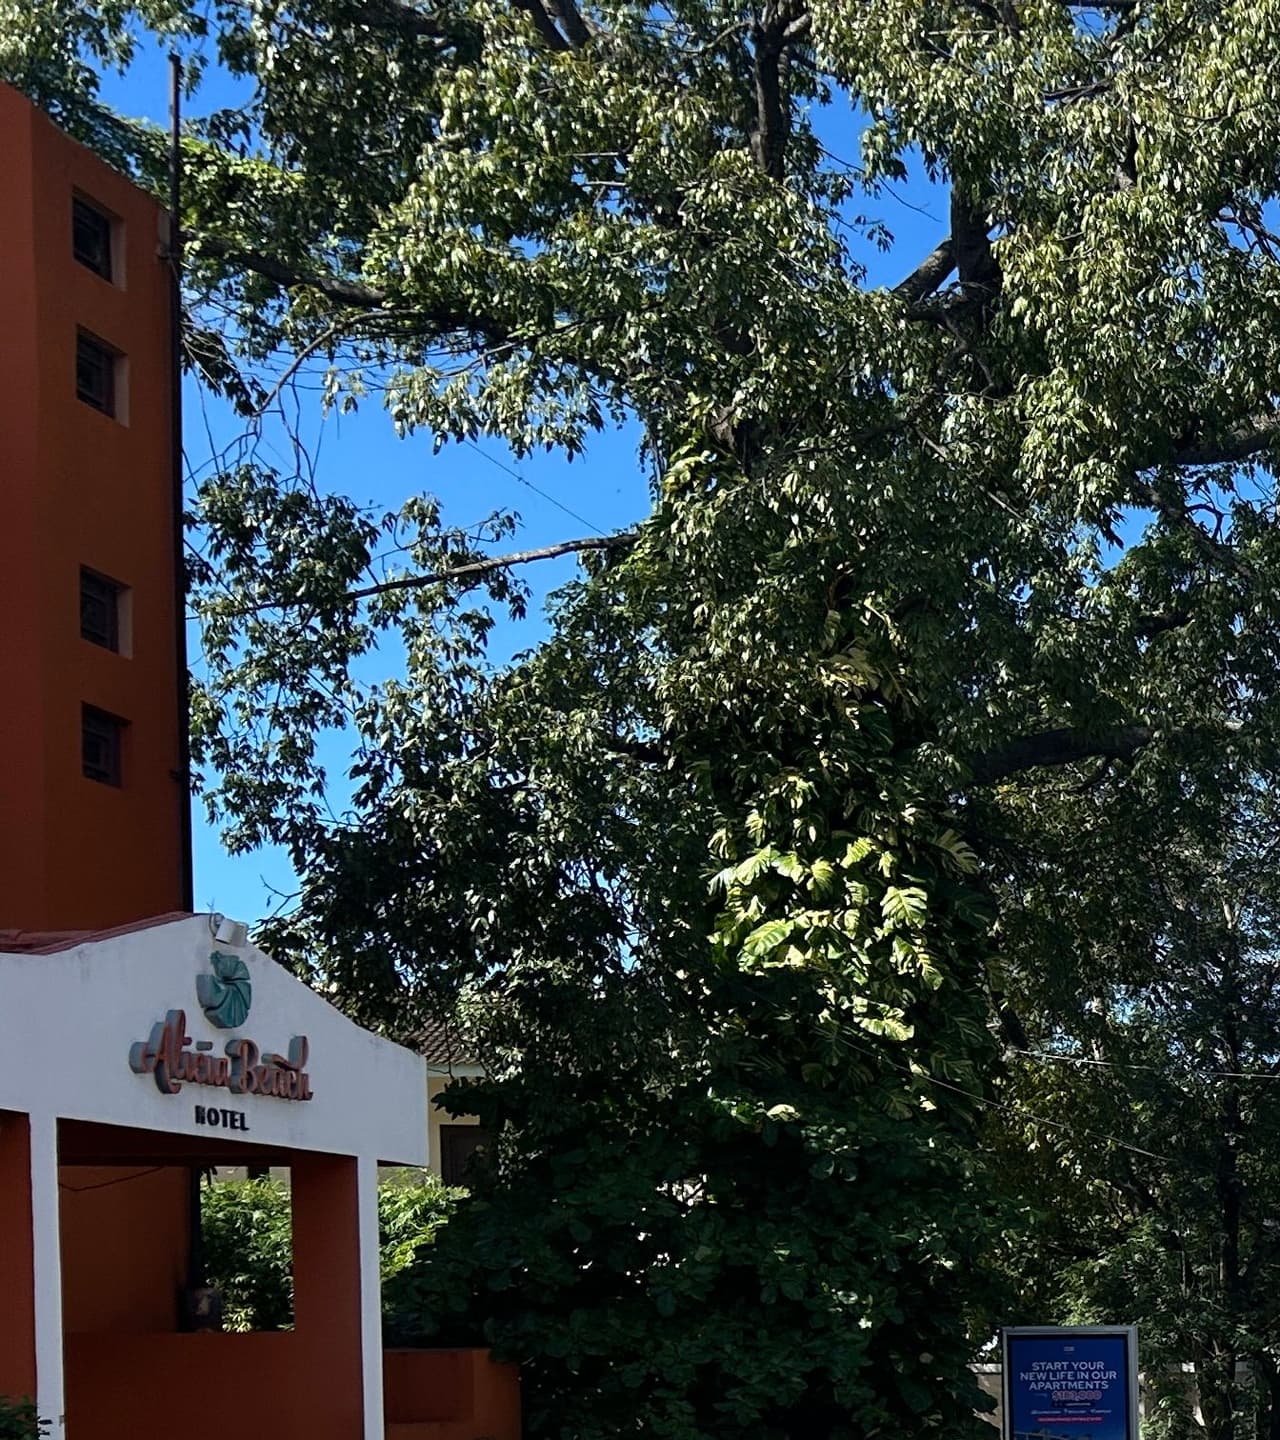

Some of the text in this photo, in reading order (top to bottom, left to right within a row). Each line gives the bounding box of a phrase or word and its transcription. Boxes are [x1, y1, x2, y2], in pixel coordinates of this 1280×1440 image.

[225, 1035, 313, 1100] Beach
[194, 1104, 249, 1131] HOTEL
[1031, 1361, 1104, 1371] START YOUR
[1019, 1370, 1117, 1381] NEW LIFE IN OUR
[1028, 1380, 1109, 1391] APARTMENTS
